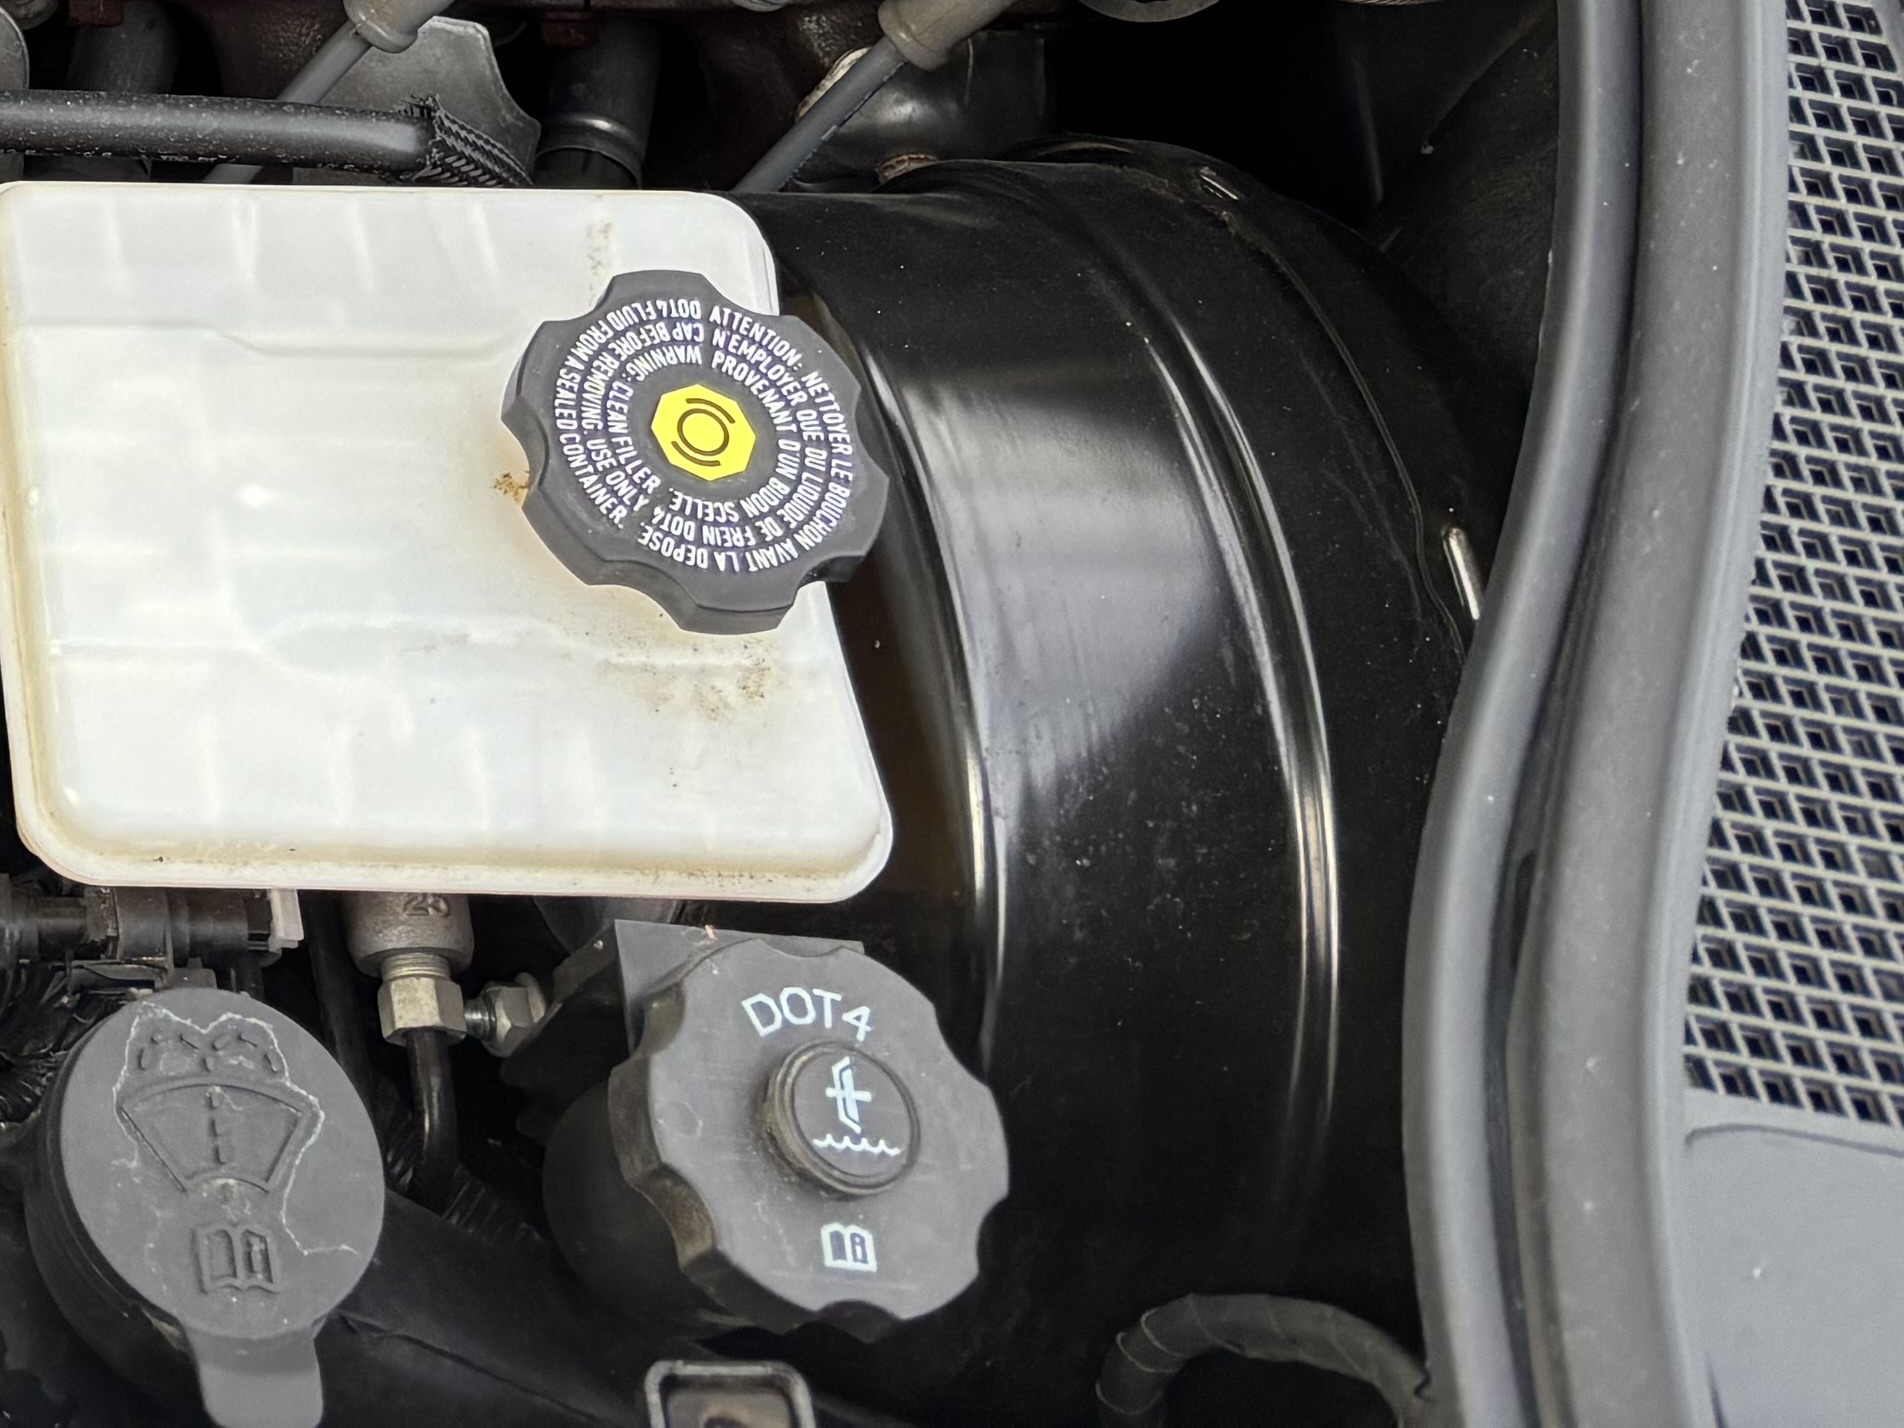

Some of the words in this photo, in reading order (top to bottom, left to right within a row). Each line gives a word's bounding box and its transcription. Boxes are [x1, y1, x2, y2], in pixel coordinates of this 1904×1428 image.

[607, 300, 657, 332] FLUID
[657, 299, 701, 318] DOT4
[573, 323, 614, 364] FROM
[617, 325, 670, 358] BEFORE
[672, 323, 704, 342] CAP
[710, 306, 803, 370] ATTENTION:
[621, 345, 702, 383] WARNING:
[554, 368, 577, 430] SEALED
[579, 352, 621, 438] REMOVING.
[606, 380, 634, 433] CLEAN
[711, 352, 795, 431] PROVENANT
[800, 371, 853, 455] NETTOYER
[800, 408, 825, 442] QUE
[587, 439, 616, 469] USE
[611, 436, 661, 495] FILLER
[775, 440, 800, 479] D'UN
[807, 447, 828, 469] DU
[835, 456, 853, 482] LE
[558, 434, 627, 529] CONTAINER.
[606, 472, 650, 513] ONLY
[668, 486, 739, 522] SCELLE.
[744, 483, 792, 521] BIDON
[799, 482, 850, 551] BOUCHON
[651, 508, 696, 541] DOT4
[705, 524, 757, 548] FREIN
[764, 513, 790, 539] DE
[638, 523, 709, 569] DEPOSE.
[717, 552, 741, 572] LA
[748, 542, 799, 572] AVANT
[741, 986, 873, 1042] DOT4
